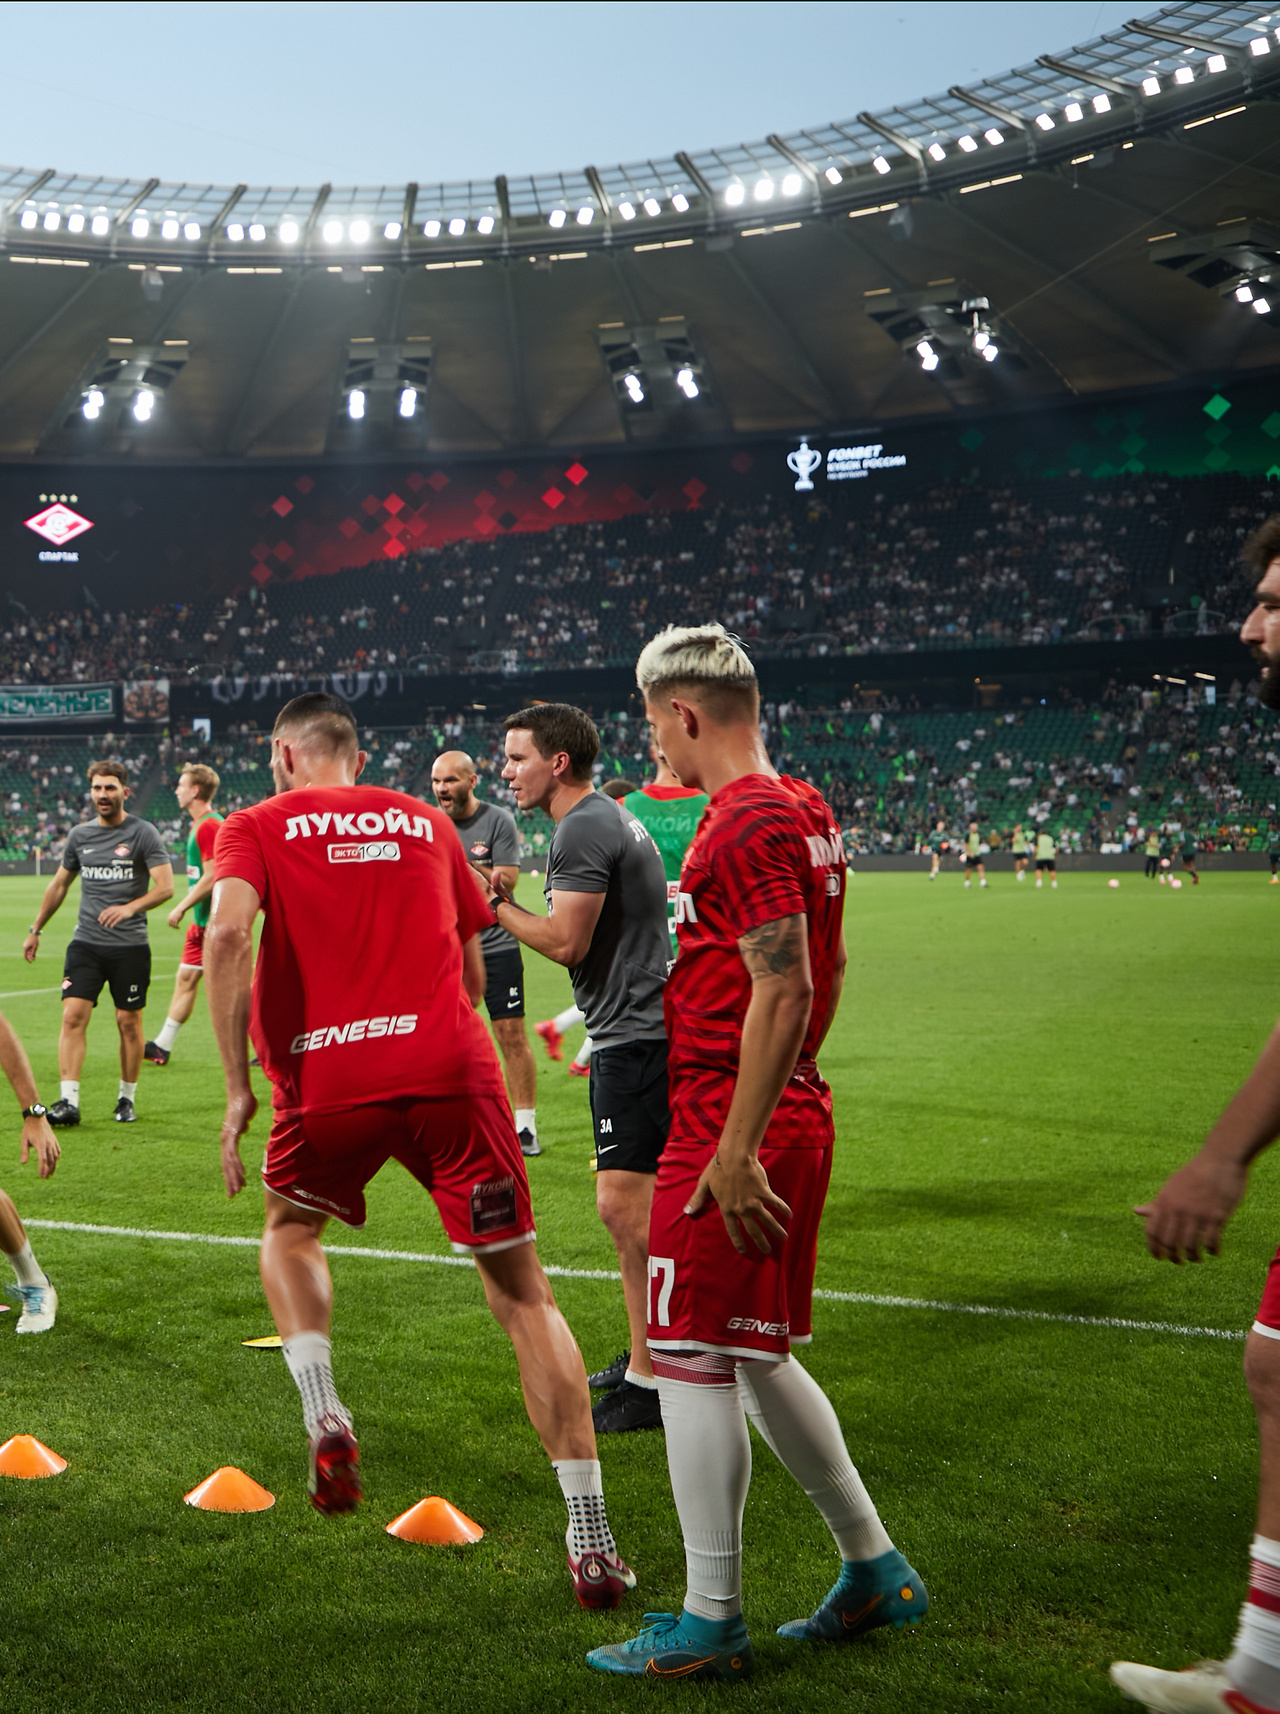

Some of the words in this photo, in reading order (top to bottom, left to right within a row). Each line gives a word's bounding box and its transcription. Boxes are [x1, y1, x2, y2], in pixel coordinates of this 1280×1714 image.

[827, 444, 883, 462] FONBET
[38, 551, 79, 562] СПАРТАК
[285, 807, 434, 843] ЛУКОЙЛ
[81, 865, 134, 880] ЛУКОЙЛ
[289, 1014, 418, 1055] GENESIS
